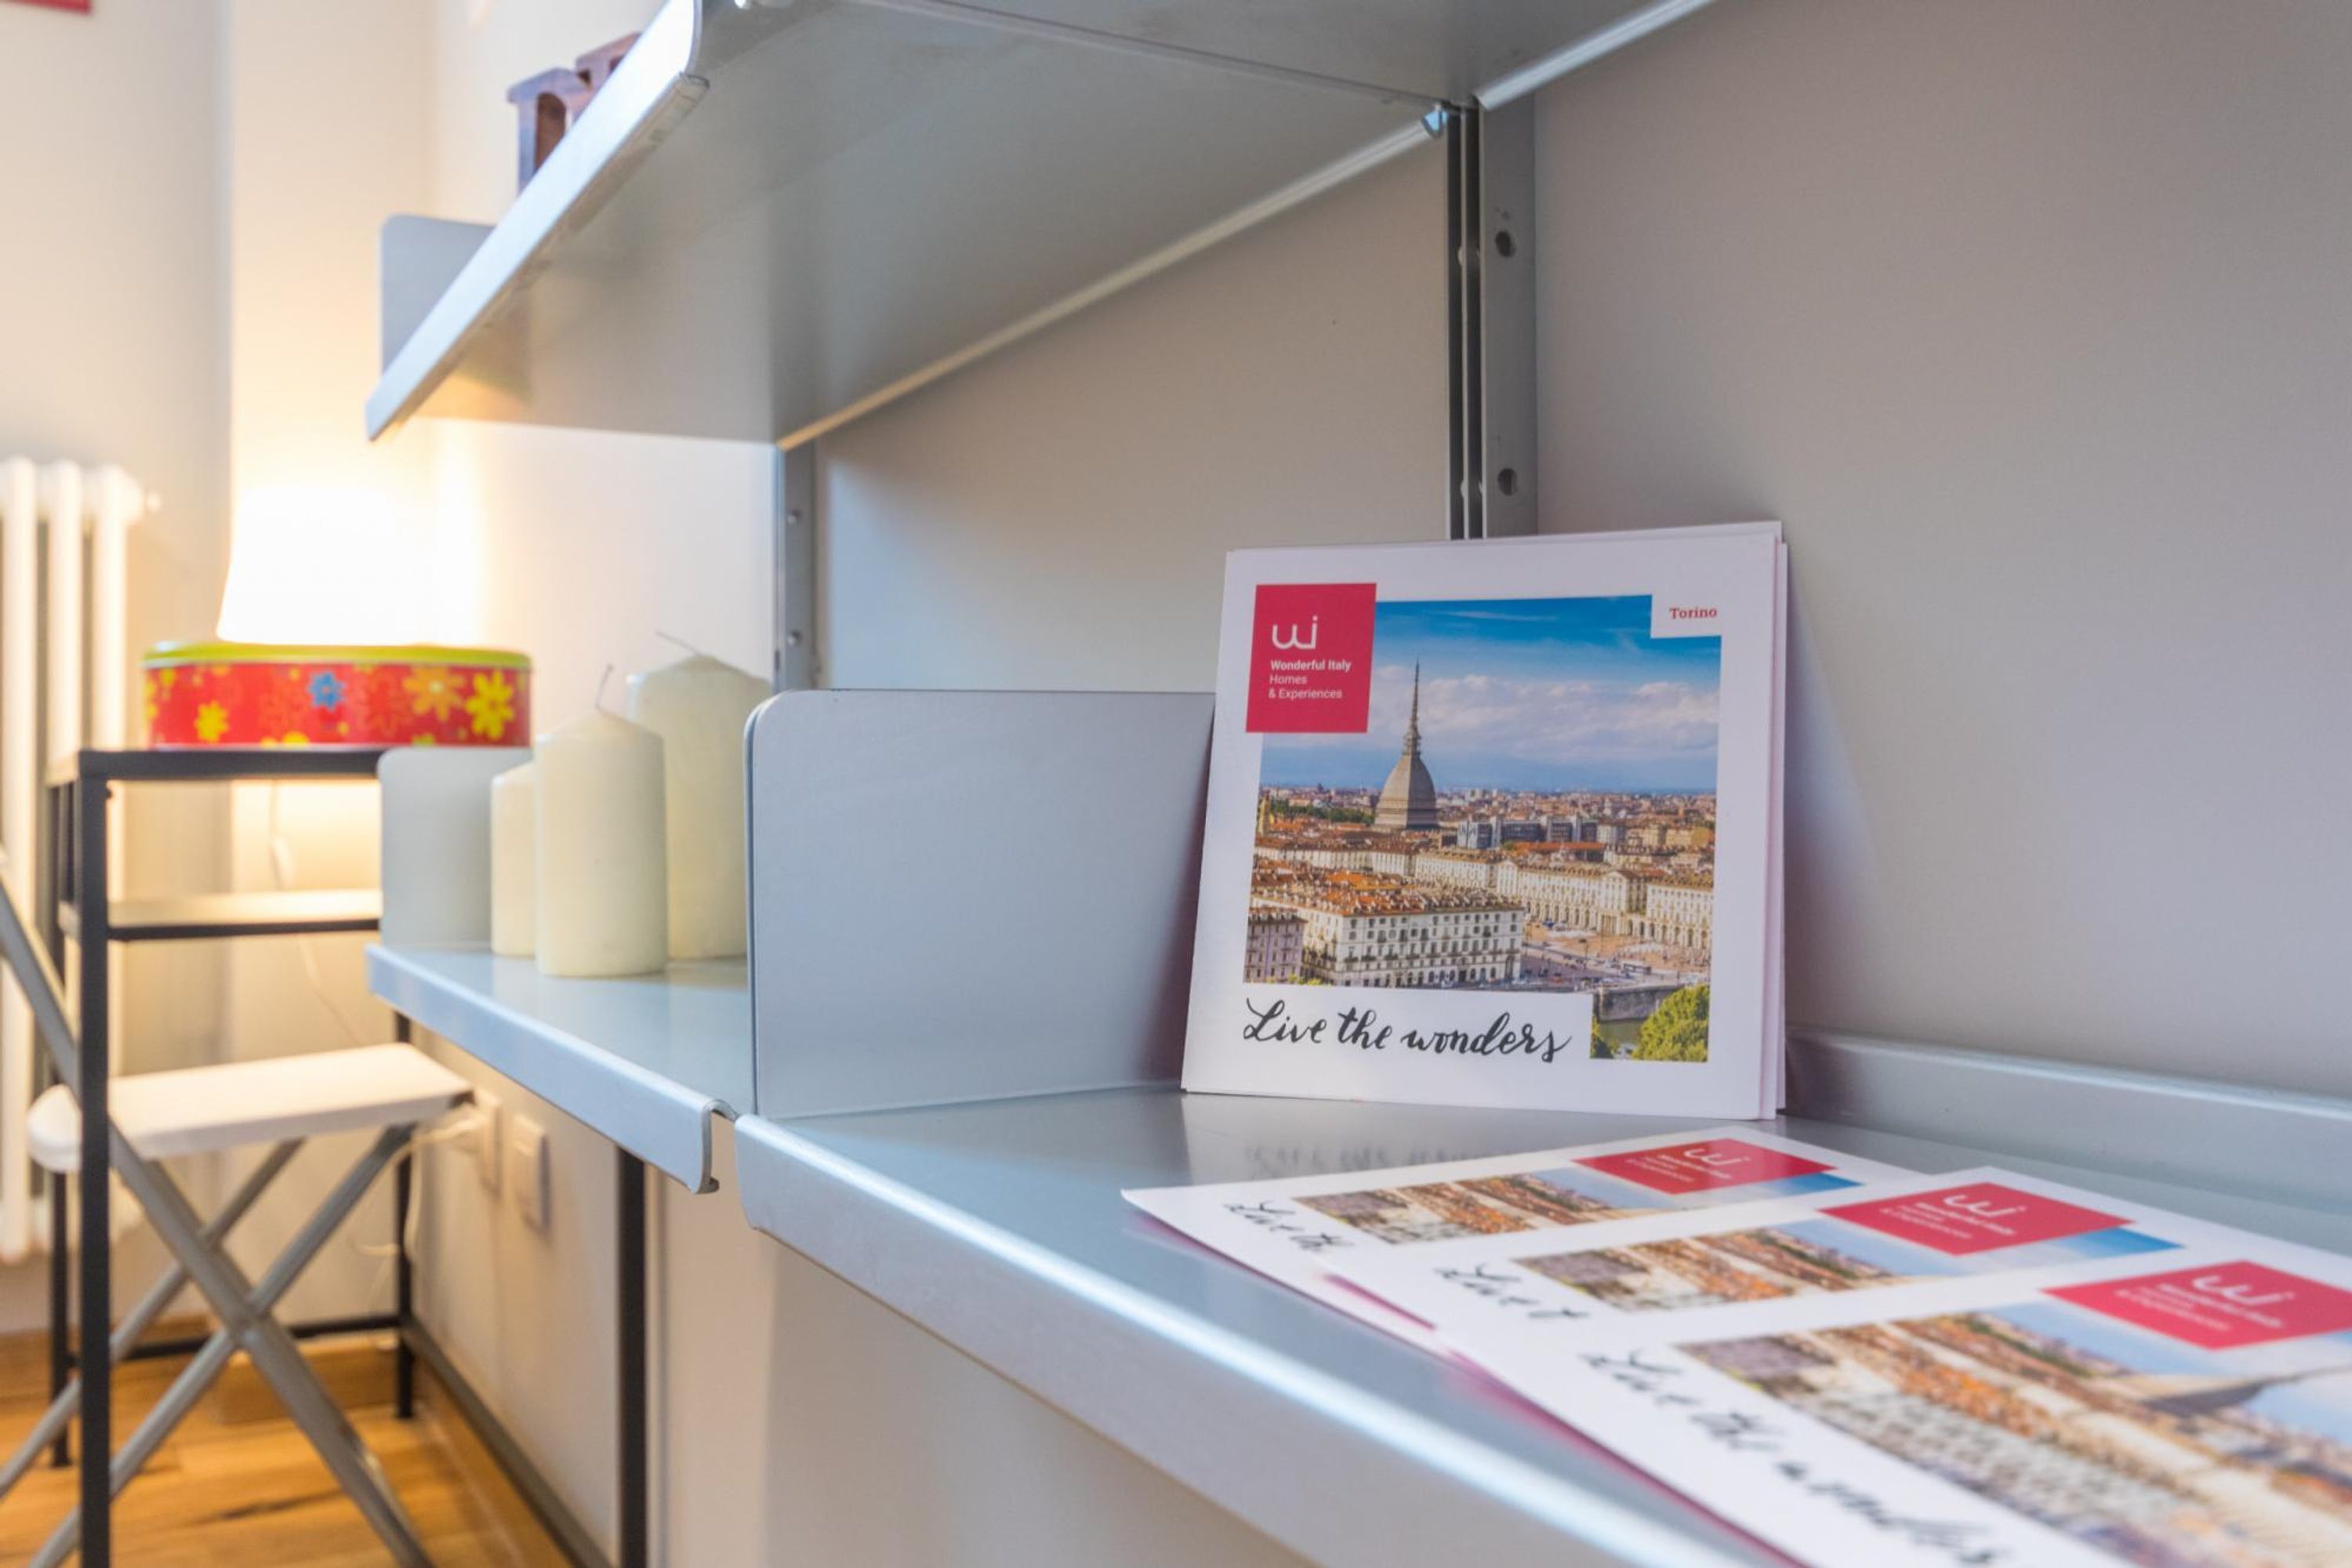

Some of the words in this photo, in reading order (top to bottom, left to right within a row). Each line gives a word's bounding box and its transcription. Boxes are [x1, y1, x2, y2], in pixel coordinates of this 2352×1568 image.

[1668, 606, 1719, 619] Torino
[1270, 659, 1325, 671] Wonderful
[1328, 659, 1352, 672] Italy
[1269, 675, 1308, 684] Homes
[1269, 688, 1276, 699] &
[1279, 688, 1342, 700] Experiences
[1243, 996, 1327, 1043] Live
[1338, 1006, 1393, 1049] the
[1400, 1011, 1573, 1063] wonders
